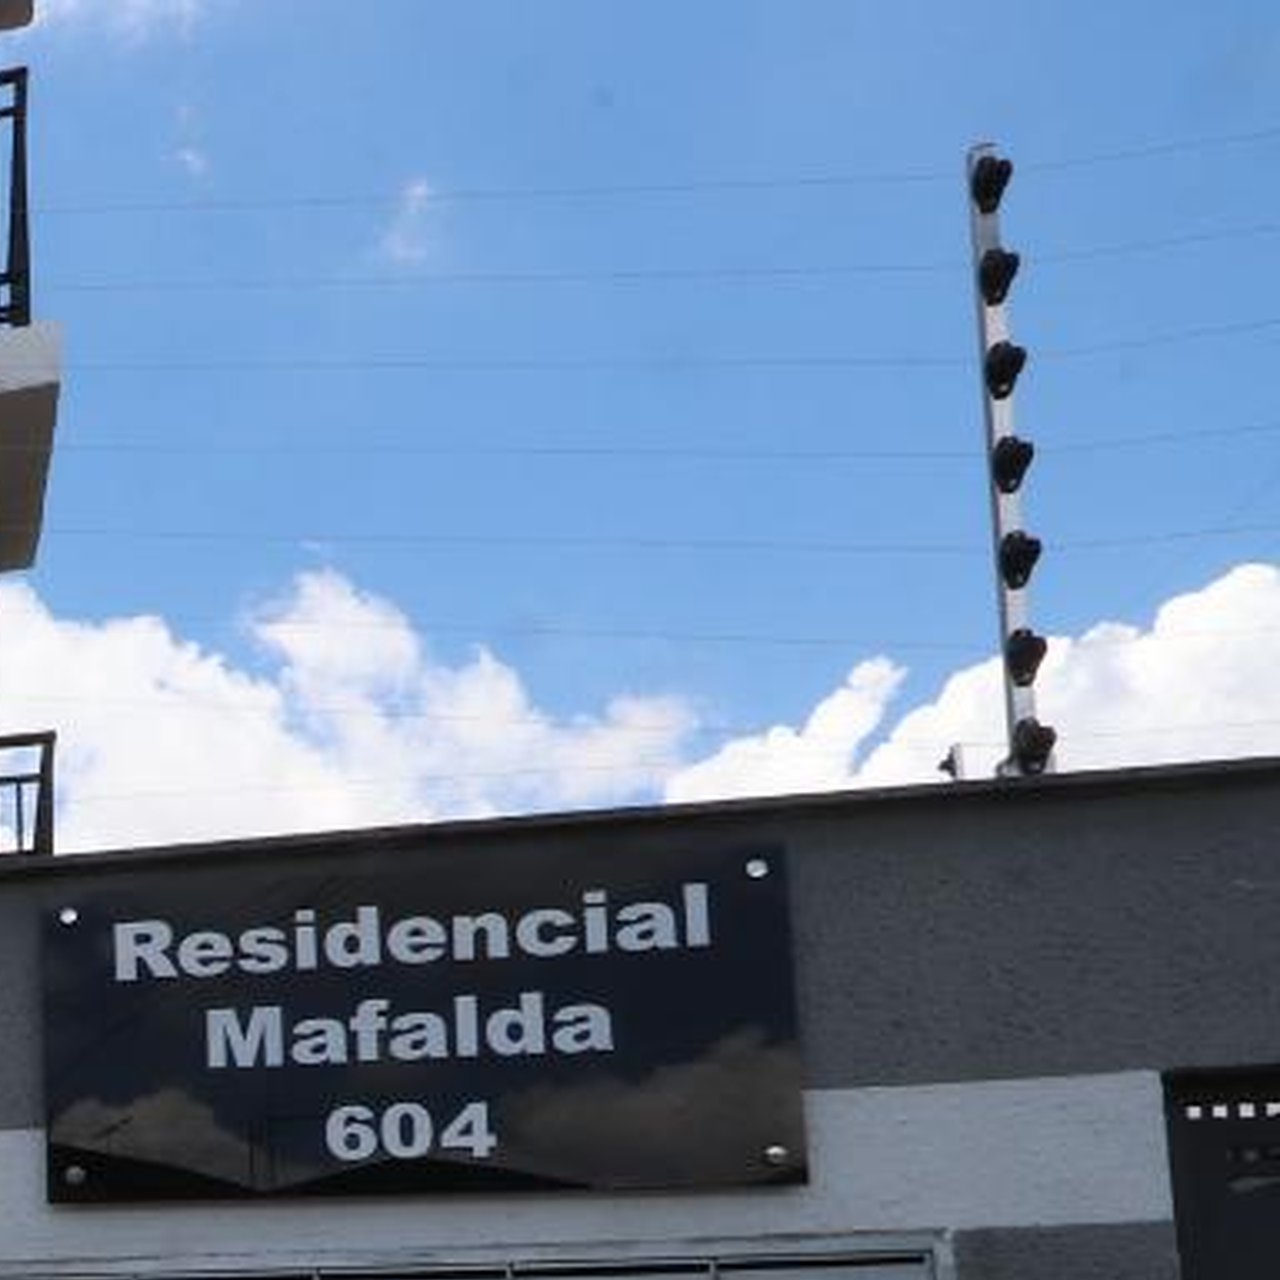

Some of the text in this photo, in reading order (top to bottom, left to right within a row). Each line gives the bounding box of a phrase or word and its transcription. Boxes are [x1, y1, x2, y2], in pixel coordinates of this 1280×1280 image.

[113, 883, 712, 981] Residencial
[204, 992, 615, 1068] Mafalda
[325, 1102, 497, 1161] 604
